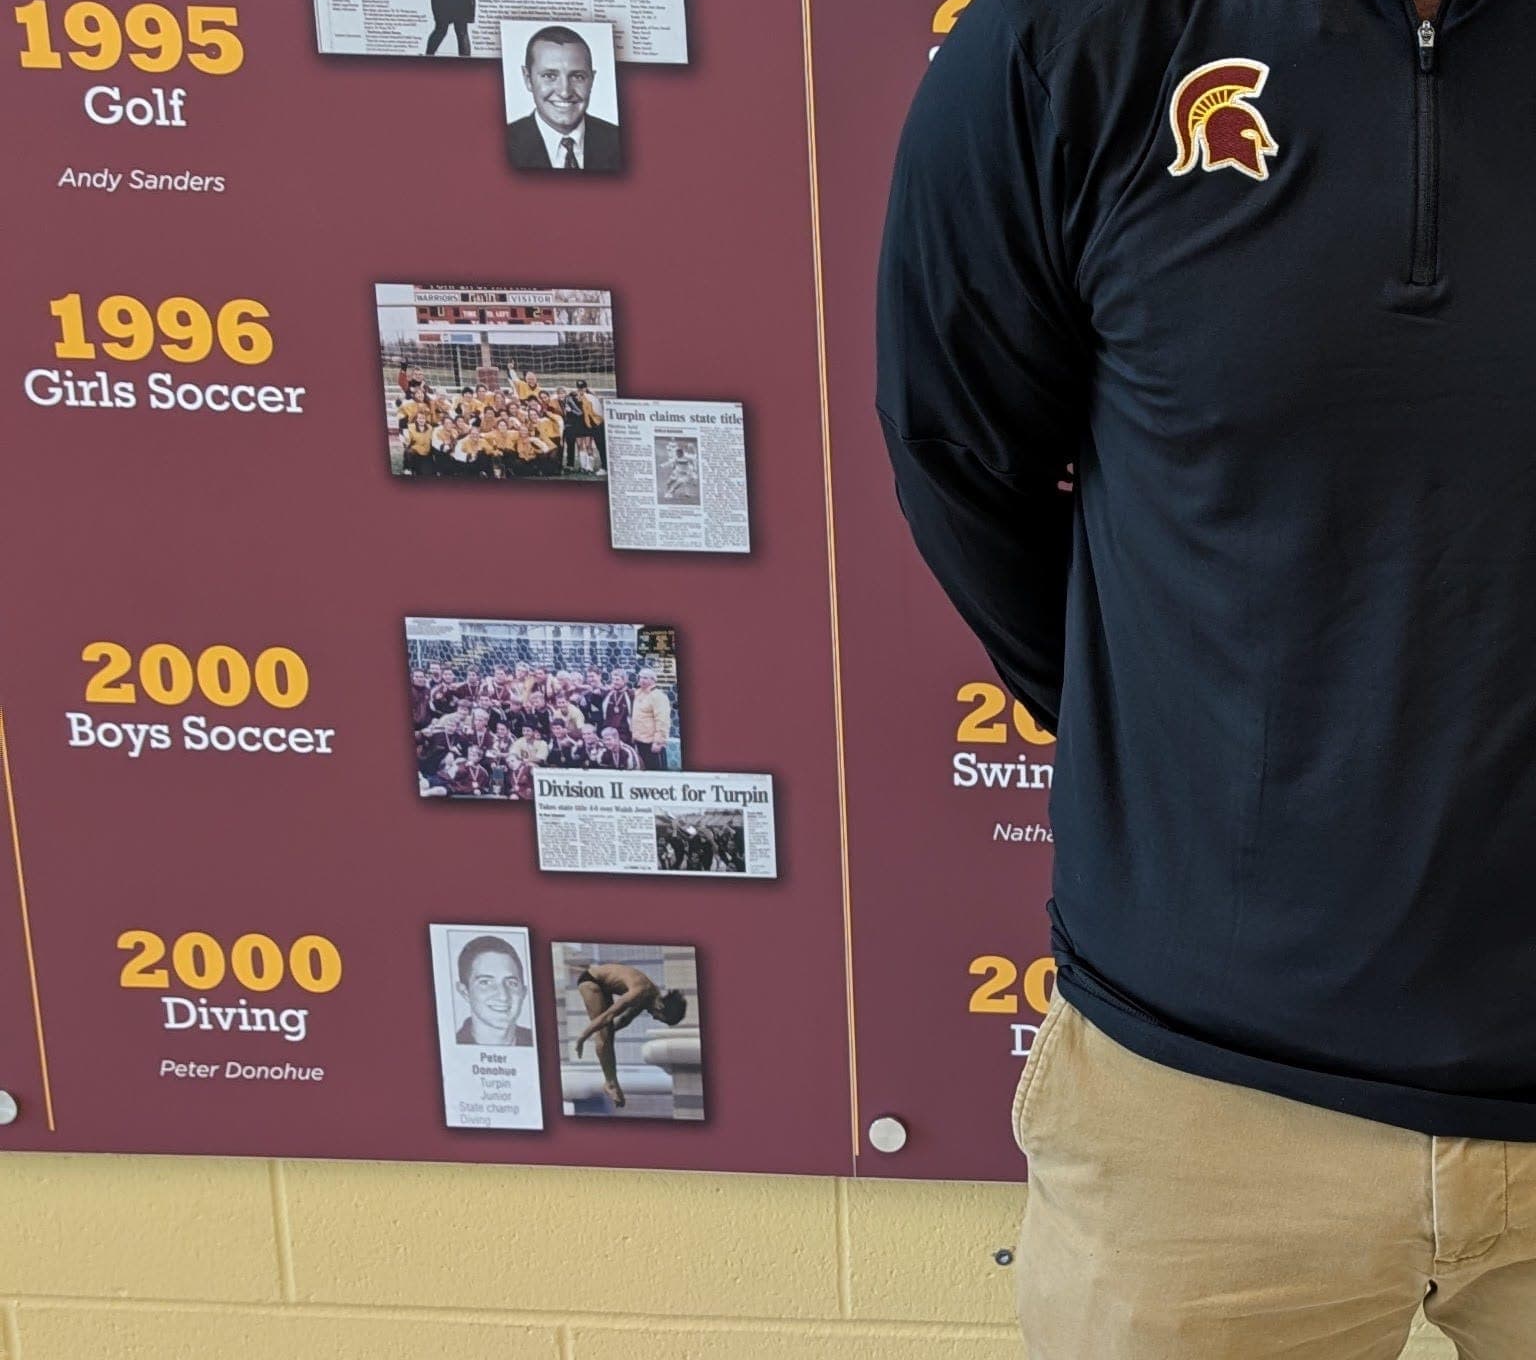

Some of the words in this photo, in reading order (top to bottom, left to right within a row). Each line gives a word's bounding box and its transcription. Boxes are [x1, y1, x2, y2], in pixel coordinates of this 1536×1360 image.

[14, 0, 244, 75] 1995
[84, 85, 187, 126] Golf
[58, 167, 122, 192] Andy
[129, 169, 225, 191] Sanders
[50, 293, 273, 365] 1996
[24, 369, 137, 408] Girls
[149, 373, 305, 413] Soccer
[606, 408, 646, 423] Turpin
[650, 411, 686, 423] claims
[689, 413, 717, 424] state
[81, 641, 309, 709] 2000
[66, 712, 171, 757] Boys
[183, 716, 335, 754] Soccer
[957, 682, 1056, 745] 20
[539, 778, 605, 799] Division
[610, 781, 623, 800] II
[630, 785, 677, 802] sweet
[682, 782, 706, 802] for
[711, 785, 769, 807] Turpin
[117, 930, 342, 993] 2000
[969, 955, 1055, 1014] 20
[161, 997, 309, 1041] Diving
[160, 1060, 220, 1078] Peter
[225, 1062, 325, 1081] Donohue
[472, 1064, 517, 1077] Donohue
[480, 1052, 507, 1064] Peter
[480, 1077, 511, 1090] Turpin
